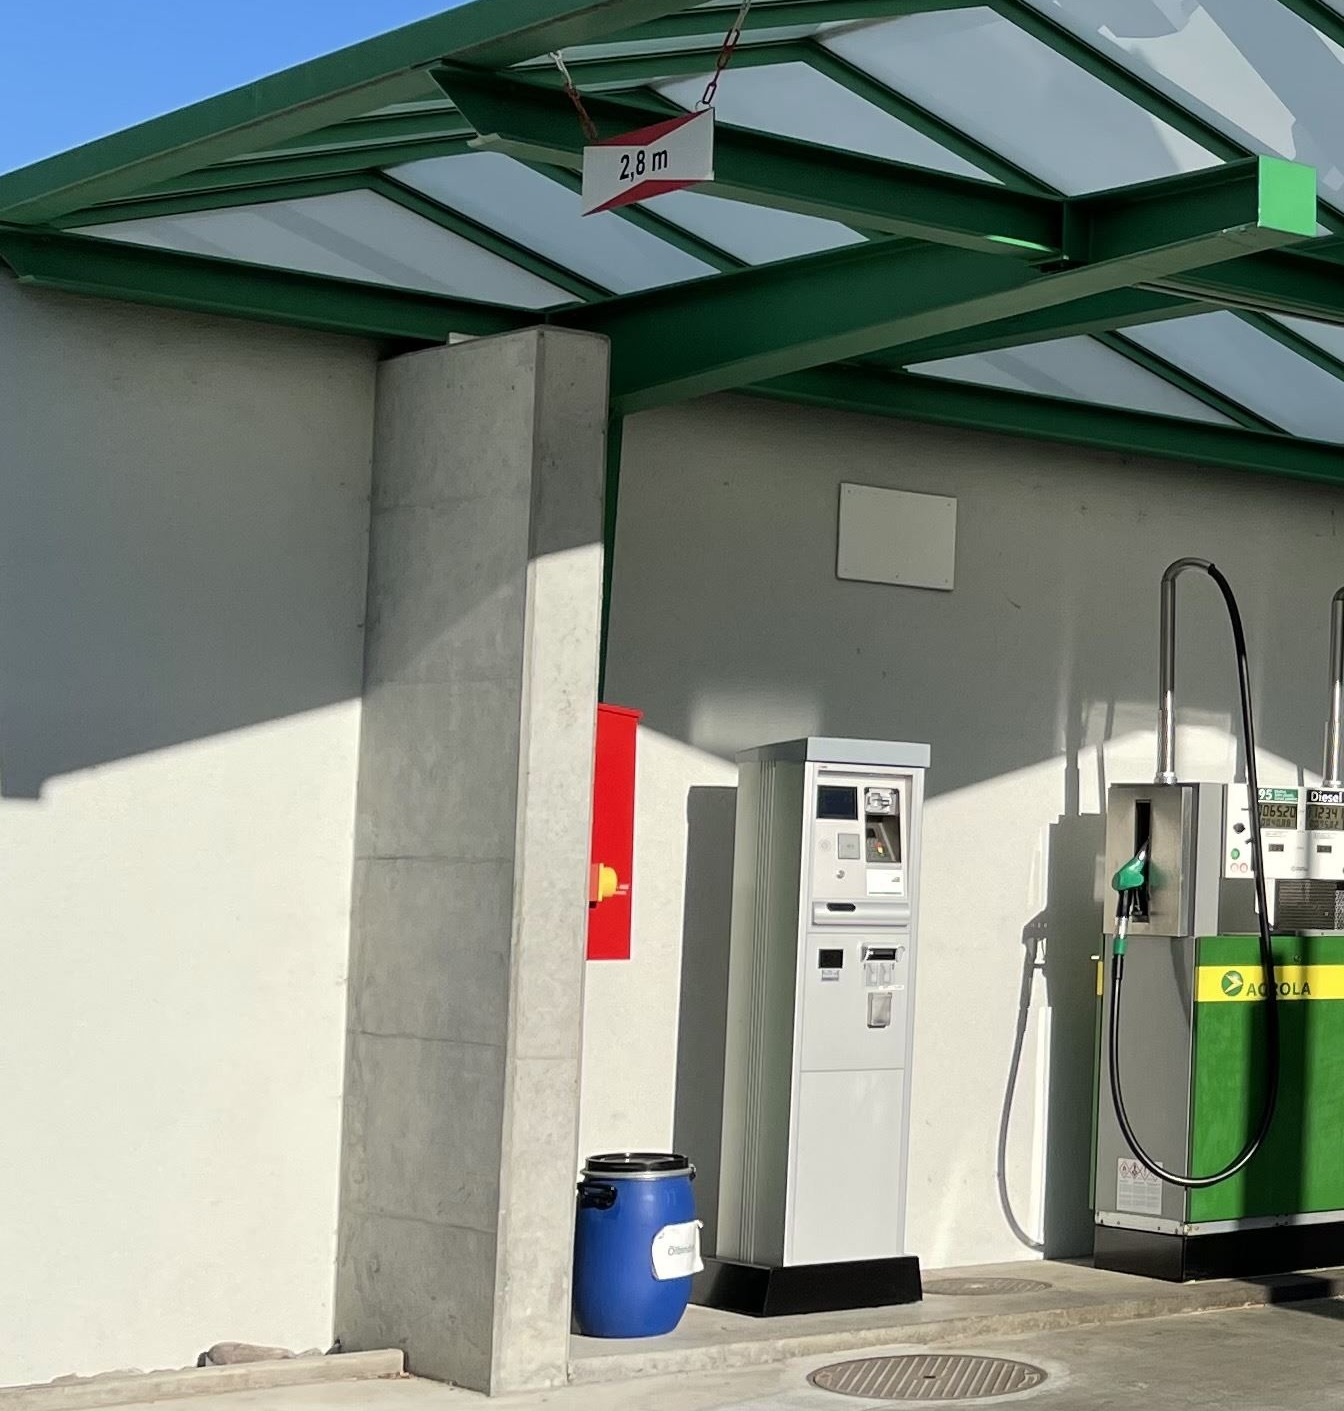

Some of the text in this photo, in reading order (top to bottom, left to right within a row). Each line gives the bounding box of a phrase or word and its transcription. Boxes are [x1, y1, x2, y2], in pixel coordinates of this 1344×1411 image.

[619, 150, 668, 182] 2,8 m
[1310, 790, 1343, 803] Diesel
